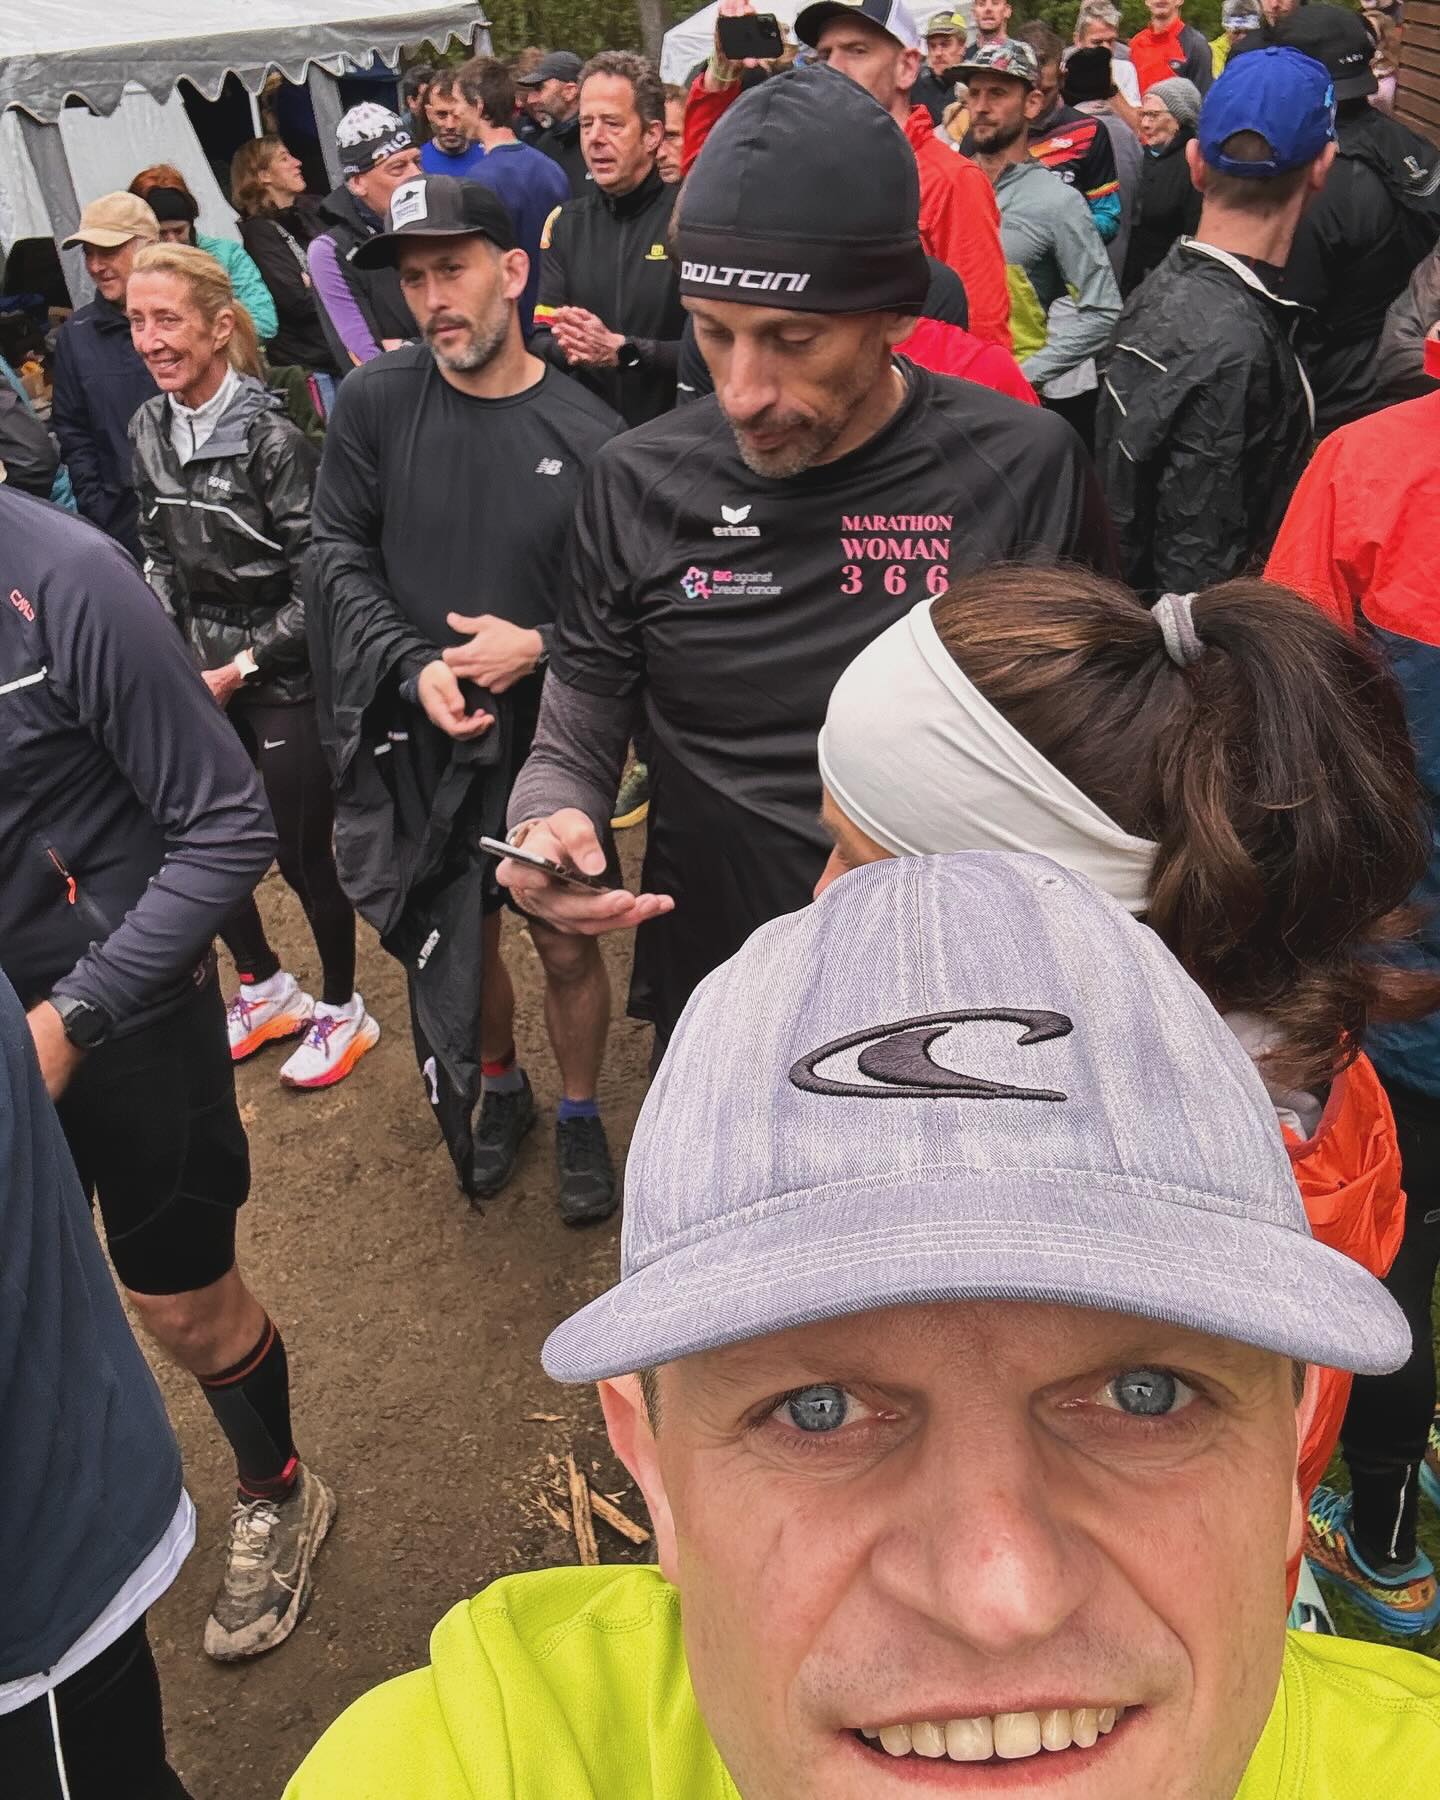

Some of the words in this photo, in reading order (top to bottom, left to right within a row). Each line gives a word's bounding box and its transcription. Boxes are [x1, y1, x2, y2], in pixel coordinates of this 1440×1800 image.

[680, 260, 812, 292] DOLTCINI
[712, 525, 761, 537] erima
[841, 514, 954, 532] MARATHON
[840, 537, 950, 560] WOMAN
